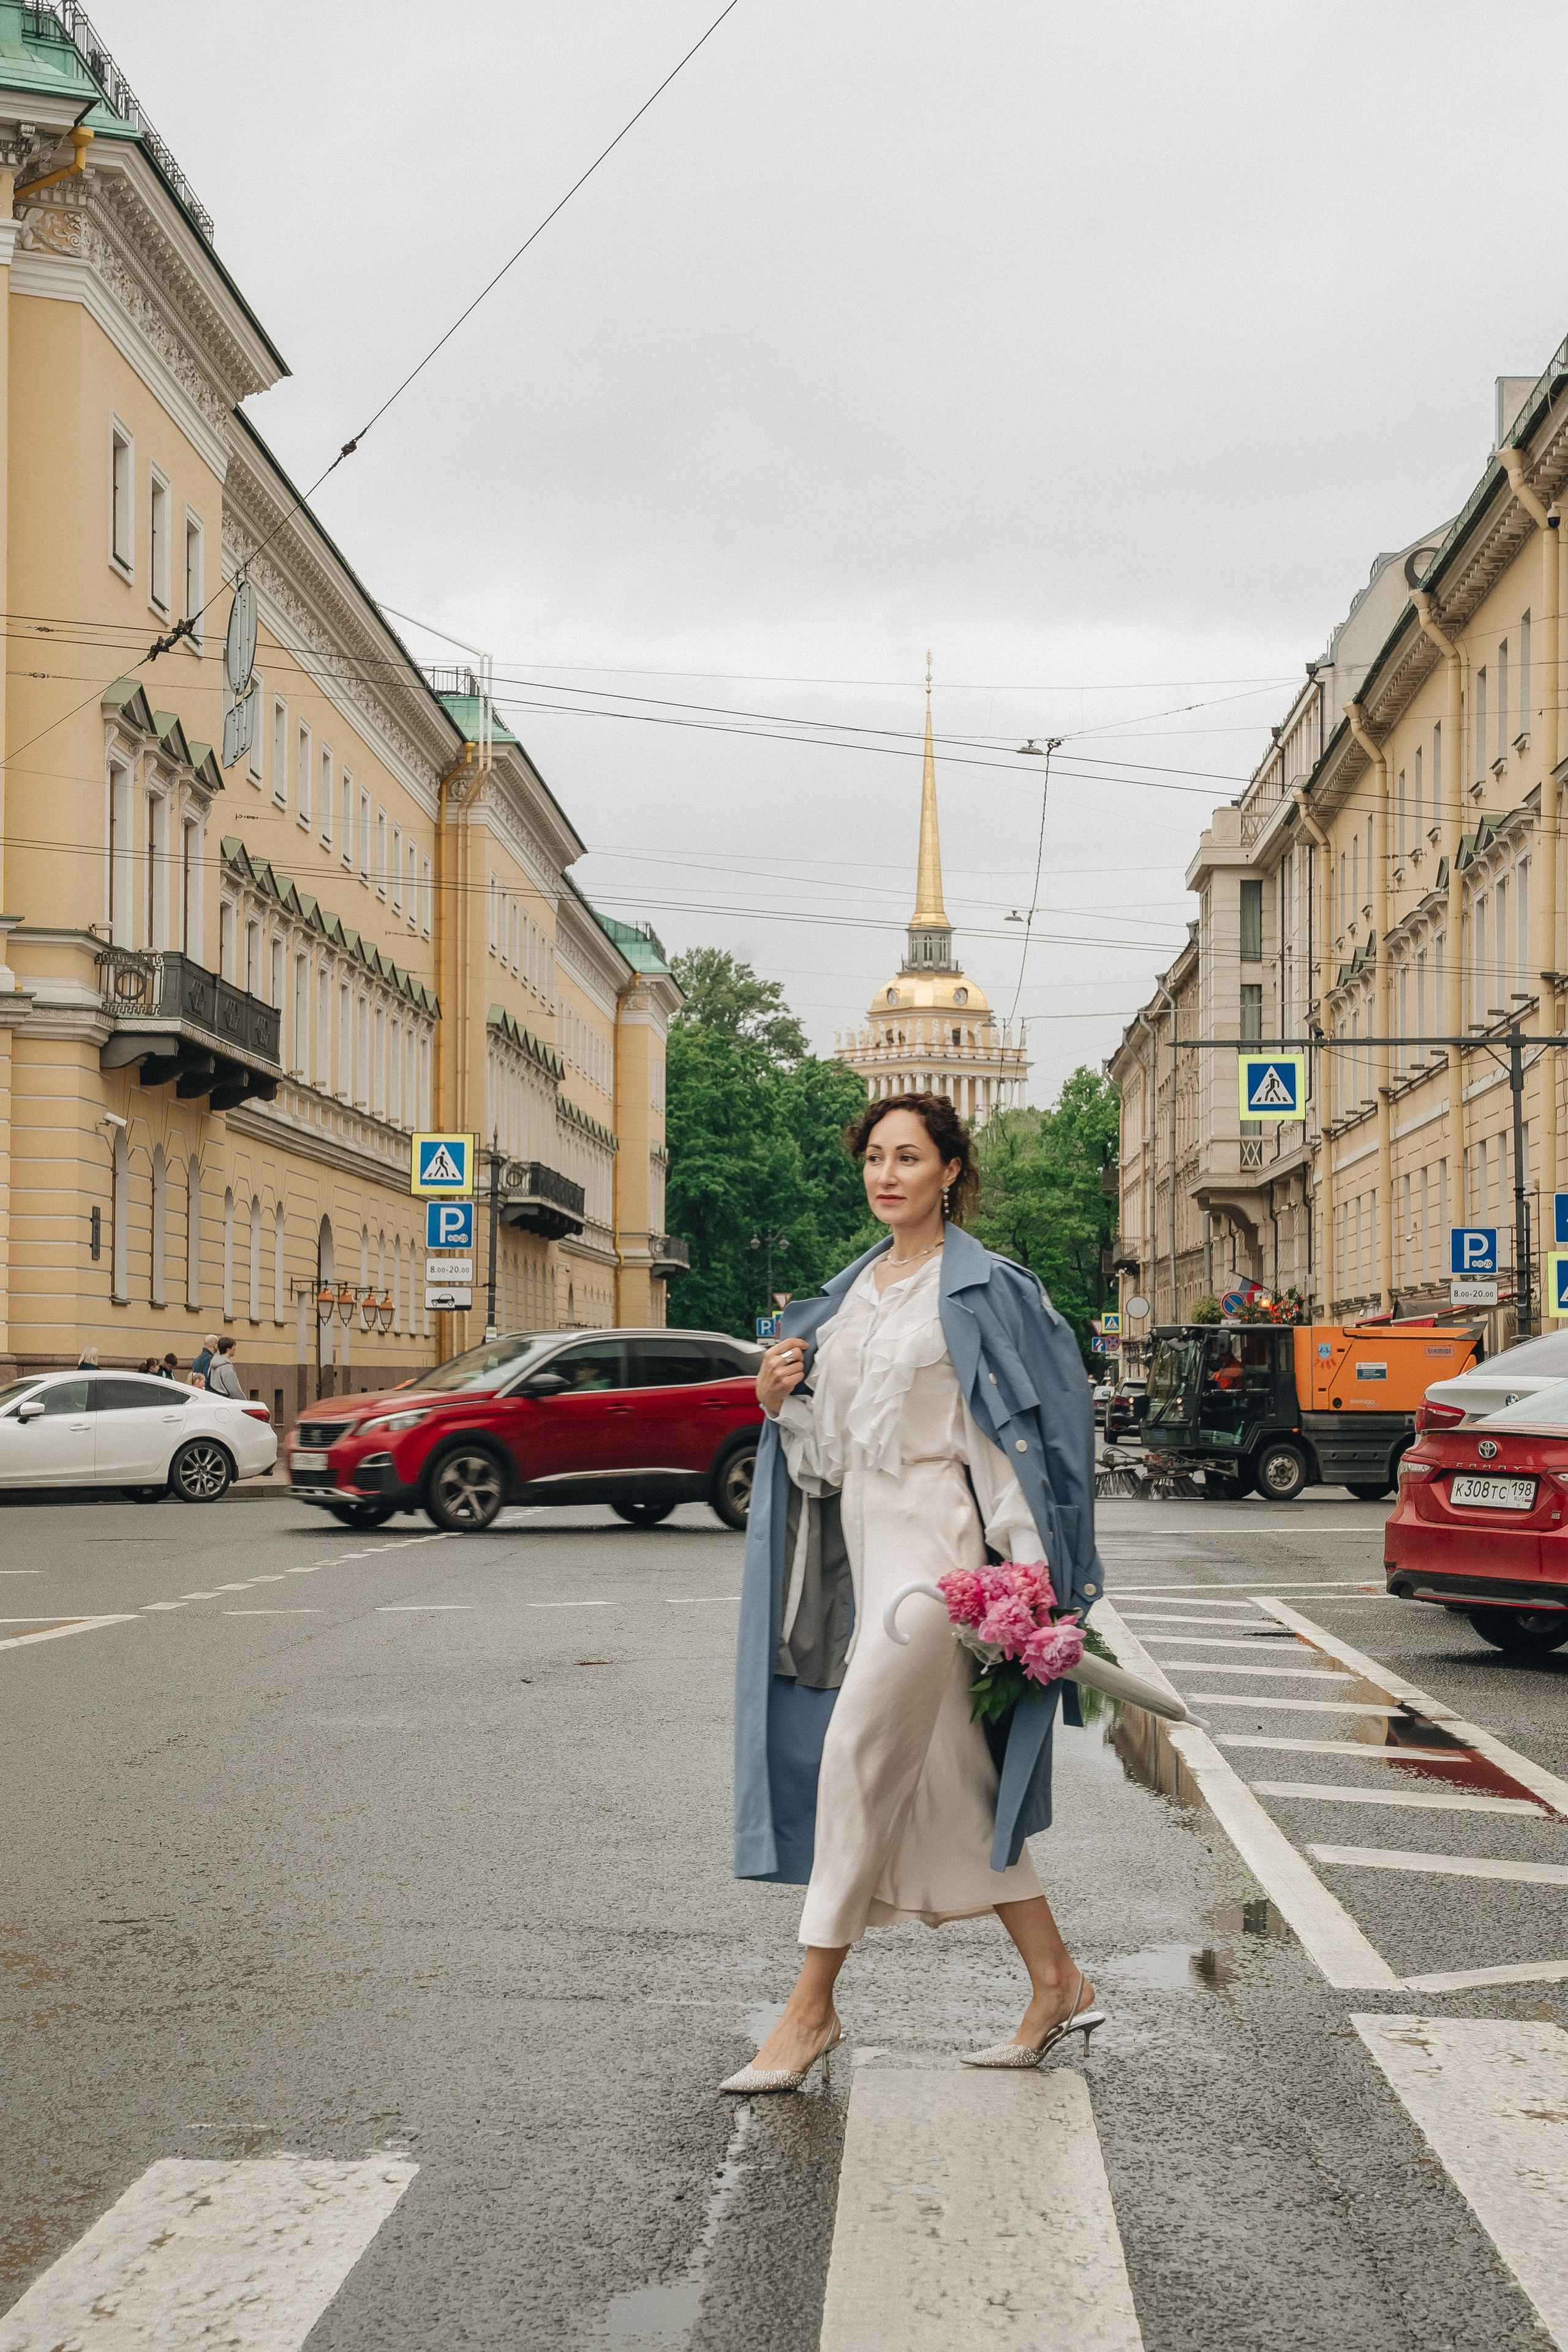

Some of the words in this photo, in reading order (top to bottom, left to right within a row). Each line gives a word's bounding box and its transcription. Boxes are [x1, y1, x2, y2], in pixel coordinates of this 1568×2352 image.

[440, 1207, 465, 1243] P
[1464, 1233, 1488, 1268] P
[761, 1320, 772, 1335] P
[1511, 1482, 1532, 1496] 198
